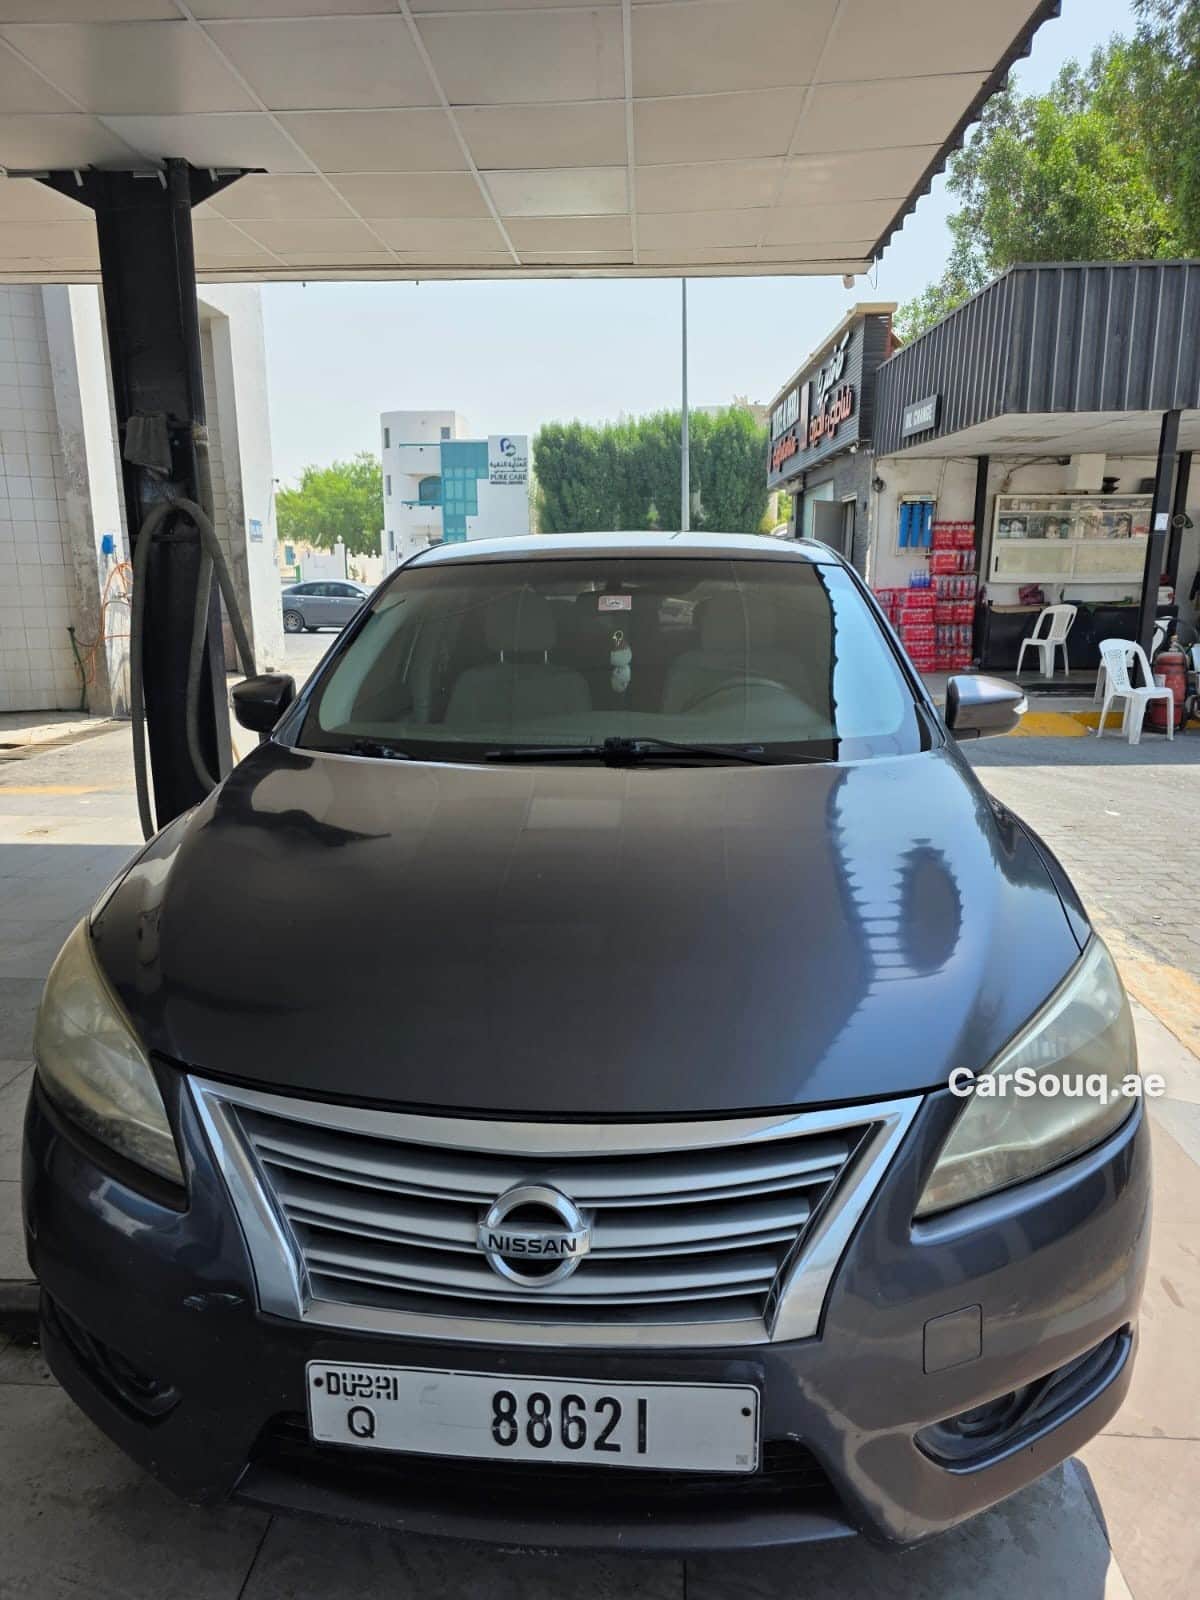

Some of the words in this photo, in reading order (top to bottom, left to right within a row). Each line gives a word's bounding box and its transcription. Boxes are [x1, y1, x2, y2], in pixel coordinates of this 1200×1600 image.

[488, 1234, 577, 1254] NISSAN
[326, 1371, 399, 1401] DUBAI
[347, 1405, 376, 1439] Q
[491, 1389, 648, 1454] 88621
